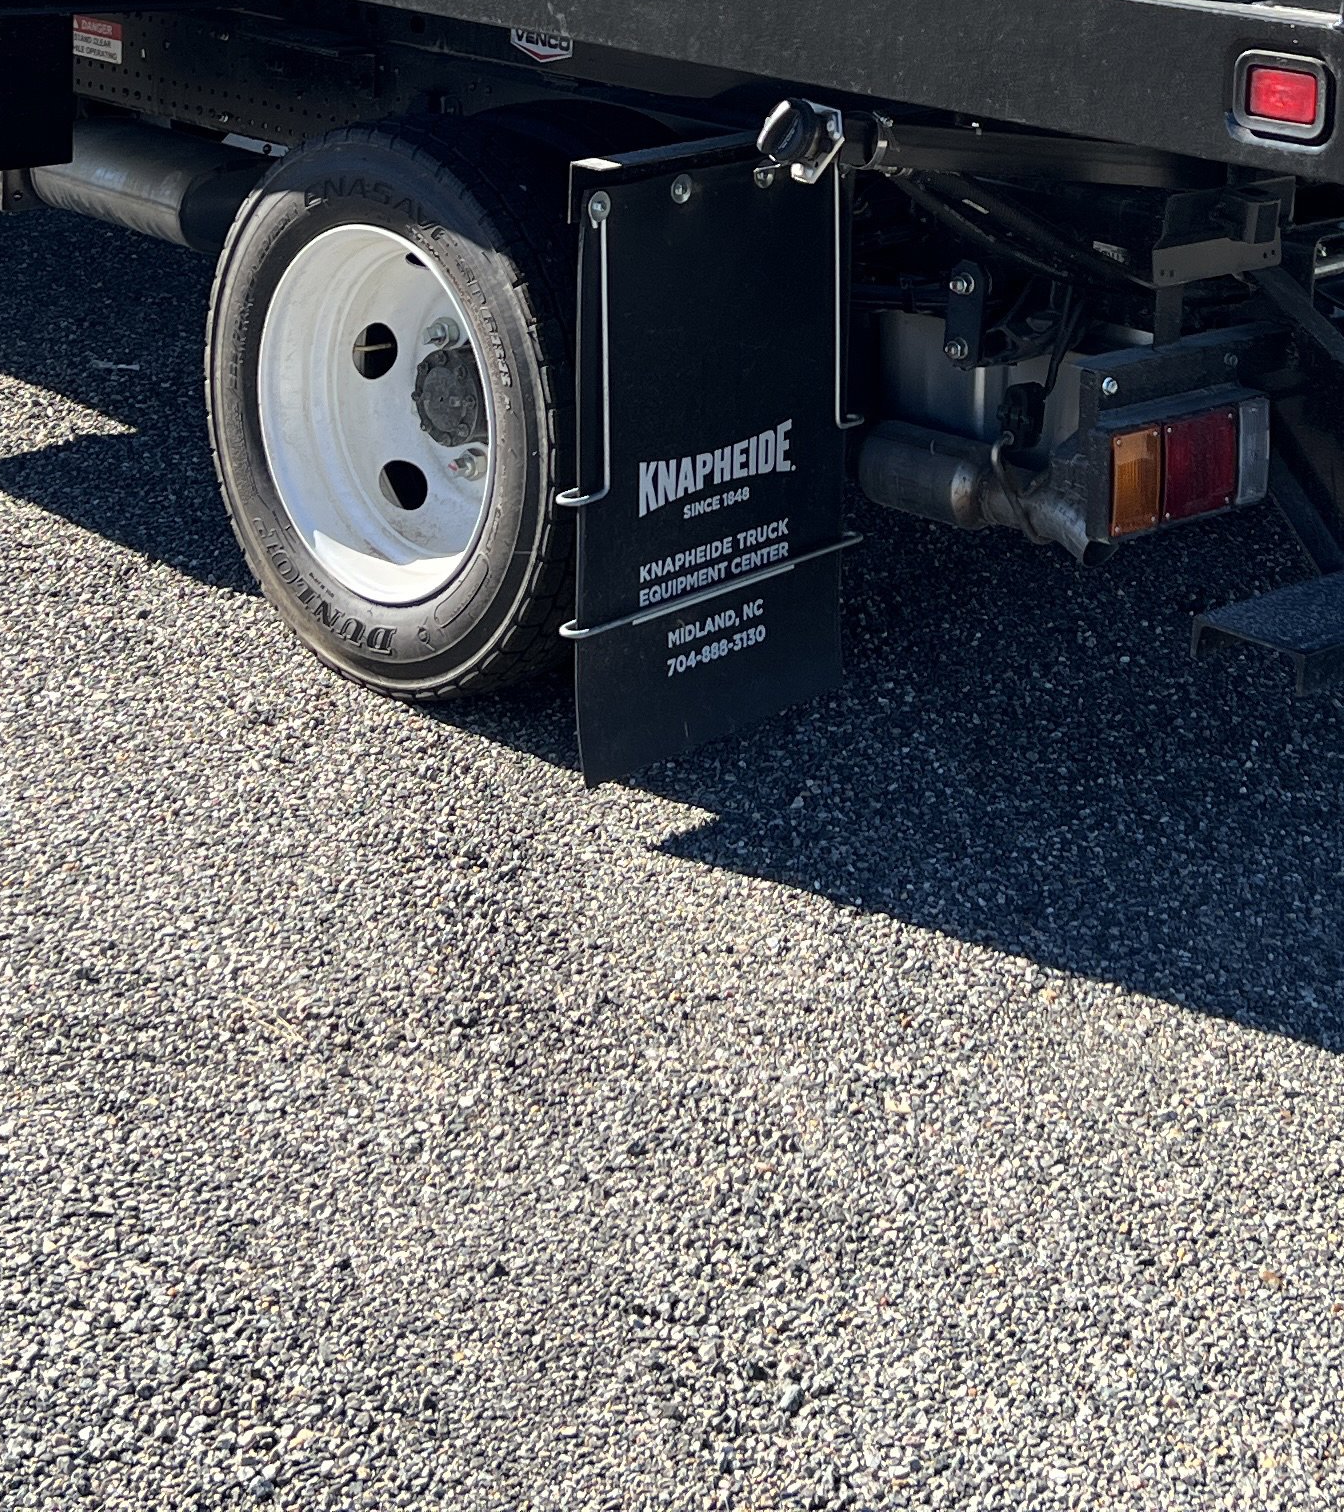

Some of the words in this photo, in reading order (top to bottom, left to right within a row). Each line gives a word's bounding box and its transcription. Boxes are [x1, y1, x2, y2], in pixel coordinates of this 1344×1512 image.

[81, 20, 113, 36] DANGER
[516, 28, 571, 52] VENCO
[683, 495, 721, 519] SINCE
[722, 486, 750, 507] 1848
[639, 536, 733, 583] KNAPHEIDE
[736, 517, 789, 550] TRUCK
[639, 561, 728, 607] EQUIPMENT
[731, 541, 789, 574] CENTER
[252, 517, 398, 656] DUNLOP
[667, 609, 740, 649] MIDLAND,
[743, 599, 764, 621] NC
[667, 624, 766, 677] 704-888-3130
